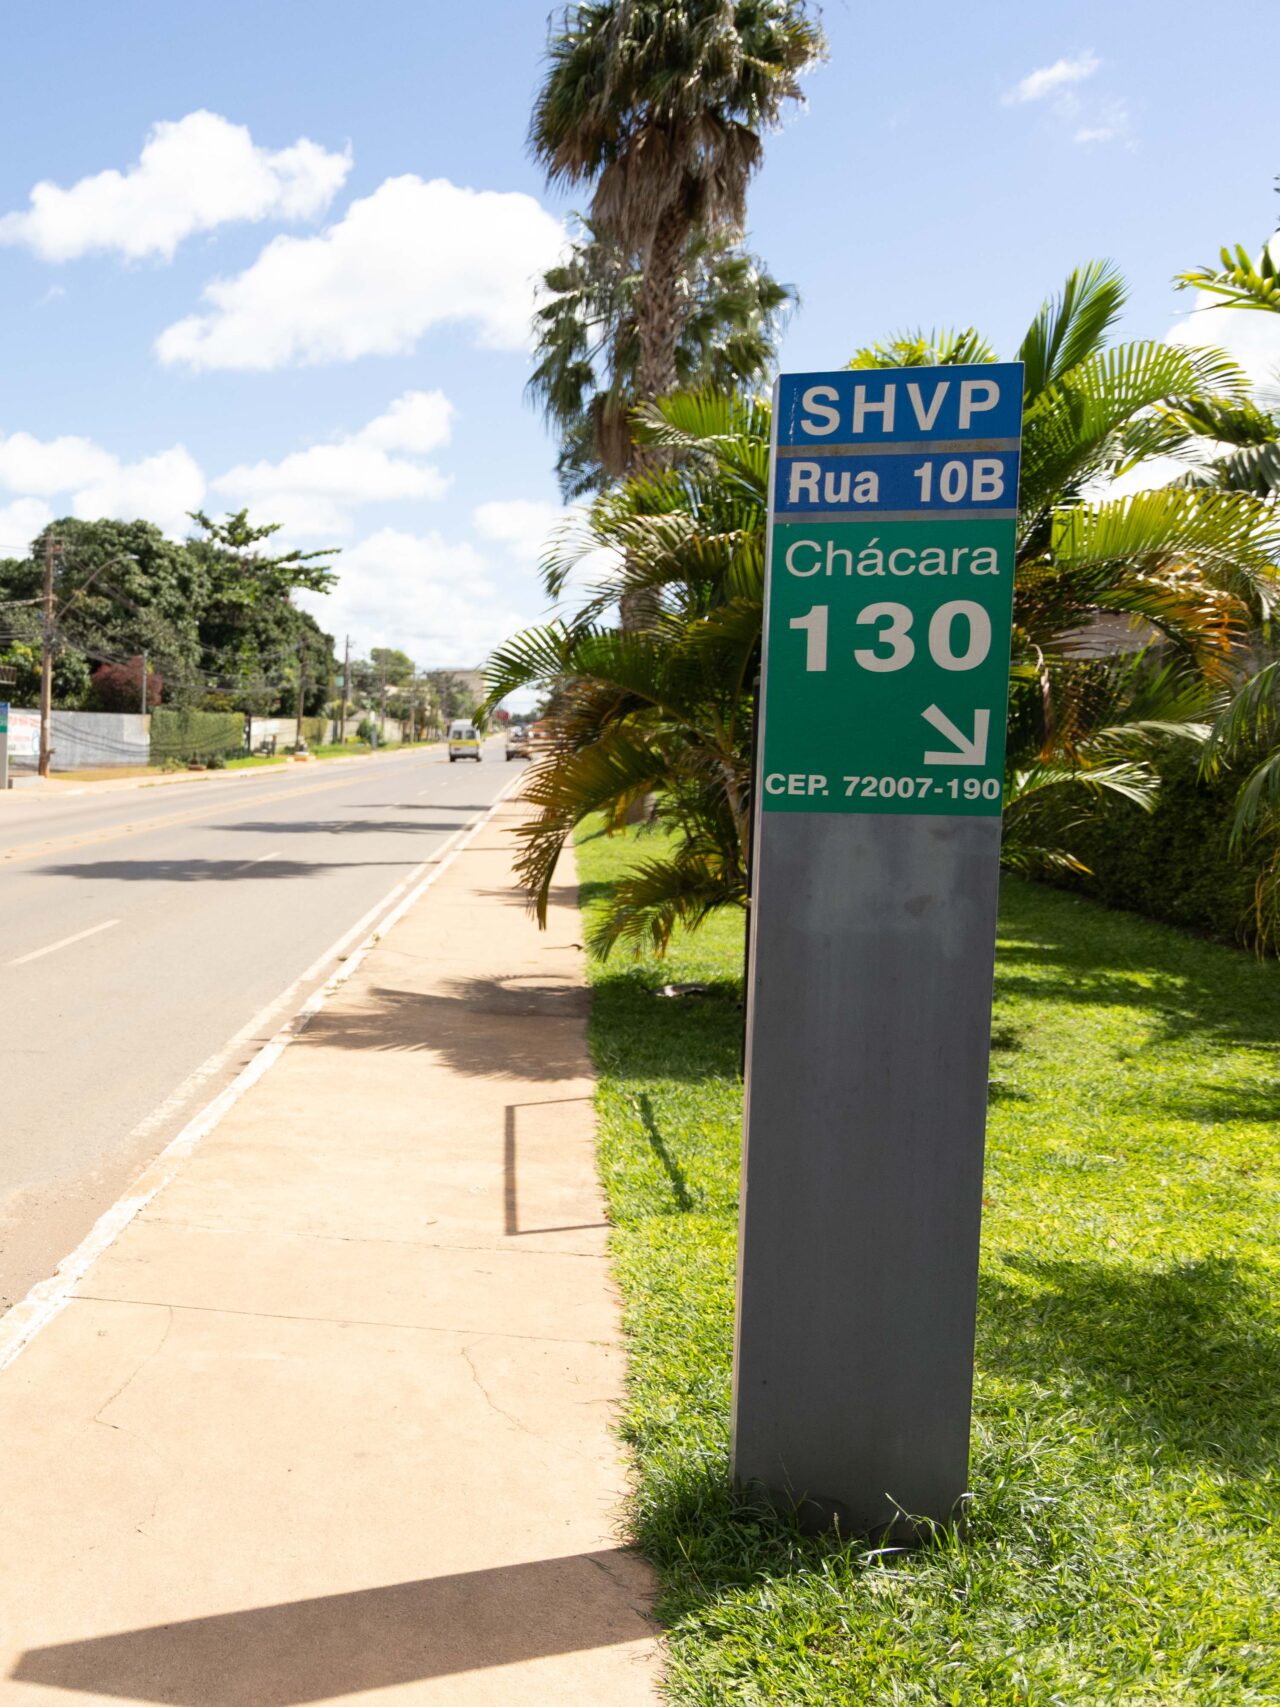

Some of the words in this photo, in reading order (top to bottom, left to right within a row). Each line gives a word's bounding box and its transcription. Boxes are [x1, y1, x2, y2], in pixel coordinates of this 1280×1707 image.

[800, 379, 1000, 436] SHVP
[789, 461, 879, 504] Rua
[913, 458, 1005, 503] 10B
[785, 536, 1000, 577] Chácara
[789, 599, 992, 673] 130
[764, 773, 829, 796] CEP.
[843, 776, 1000, 800] 72007-190
